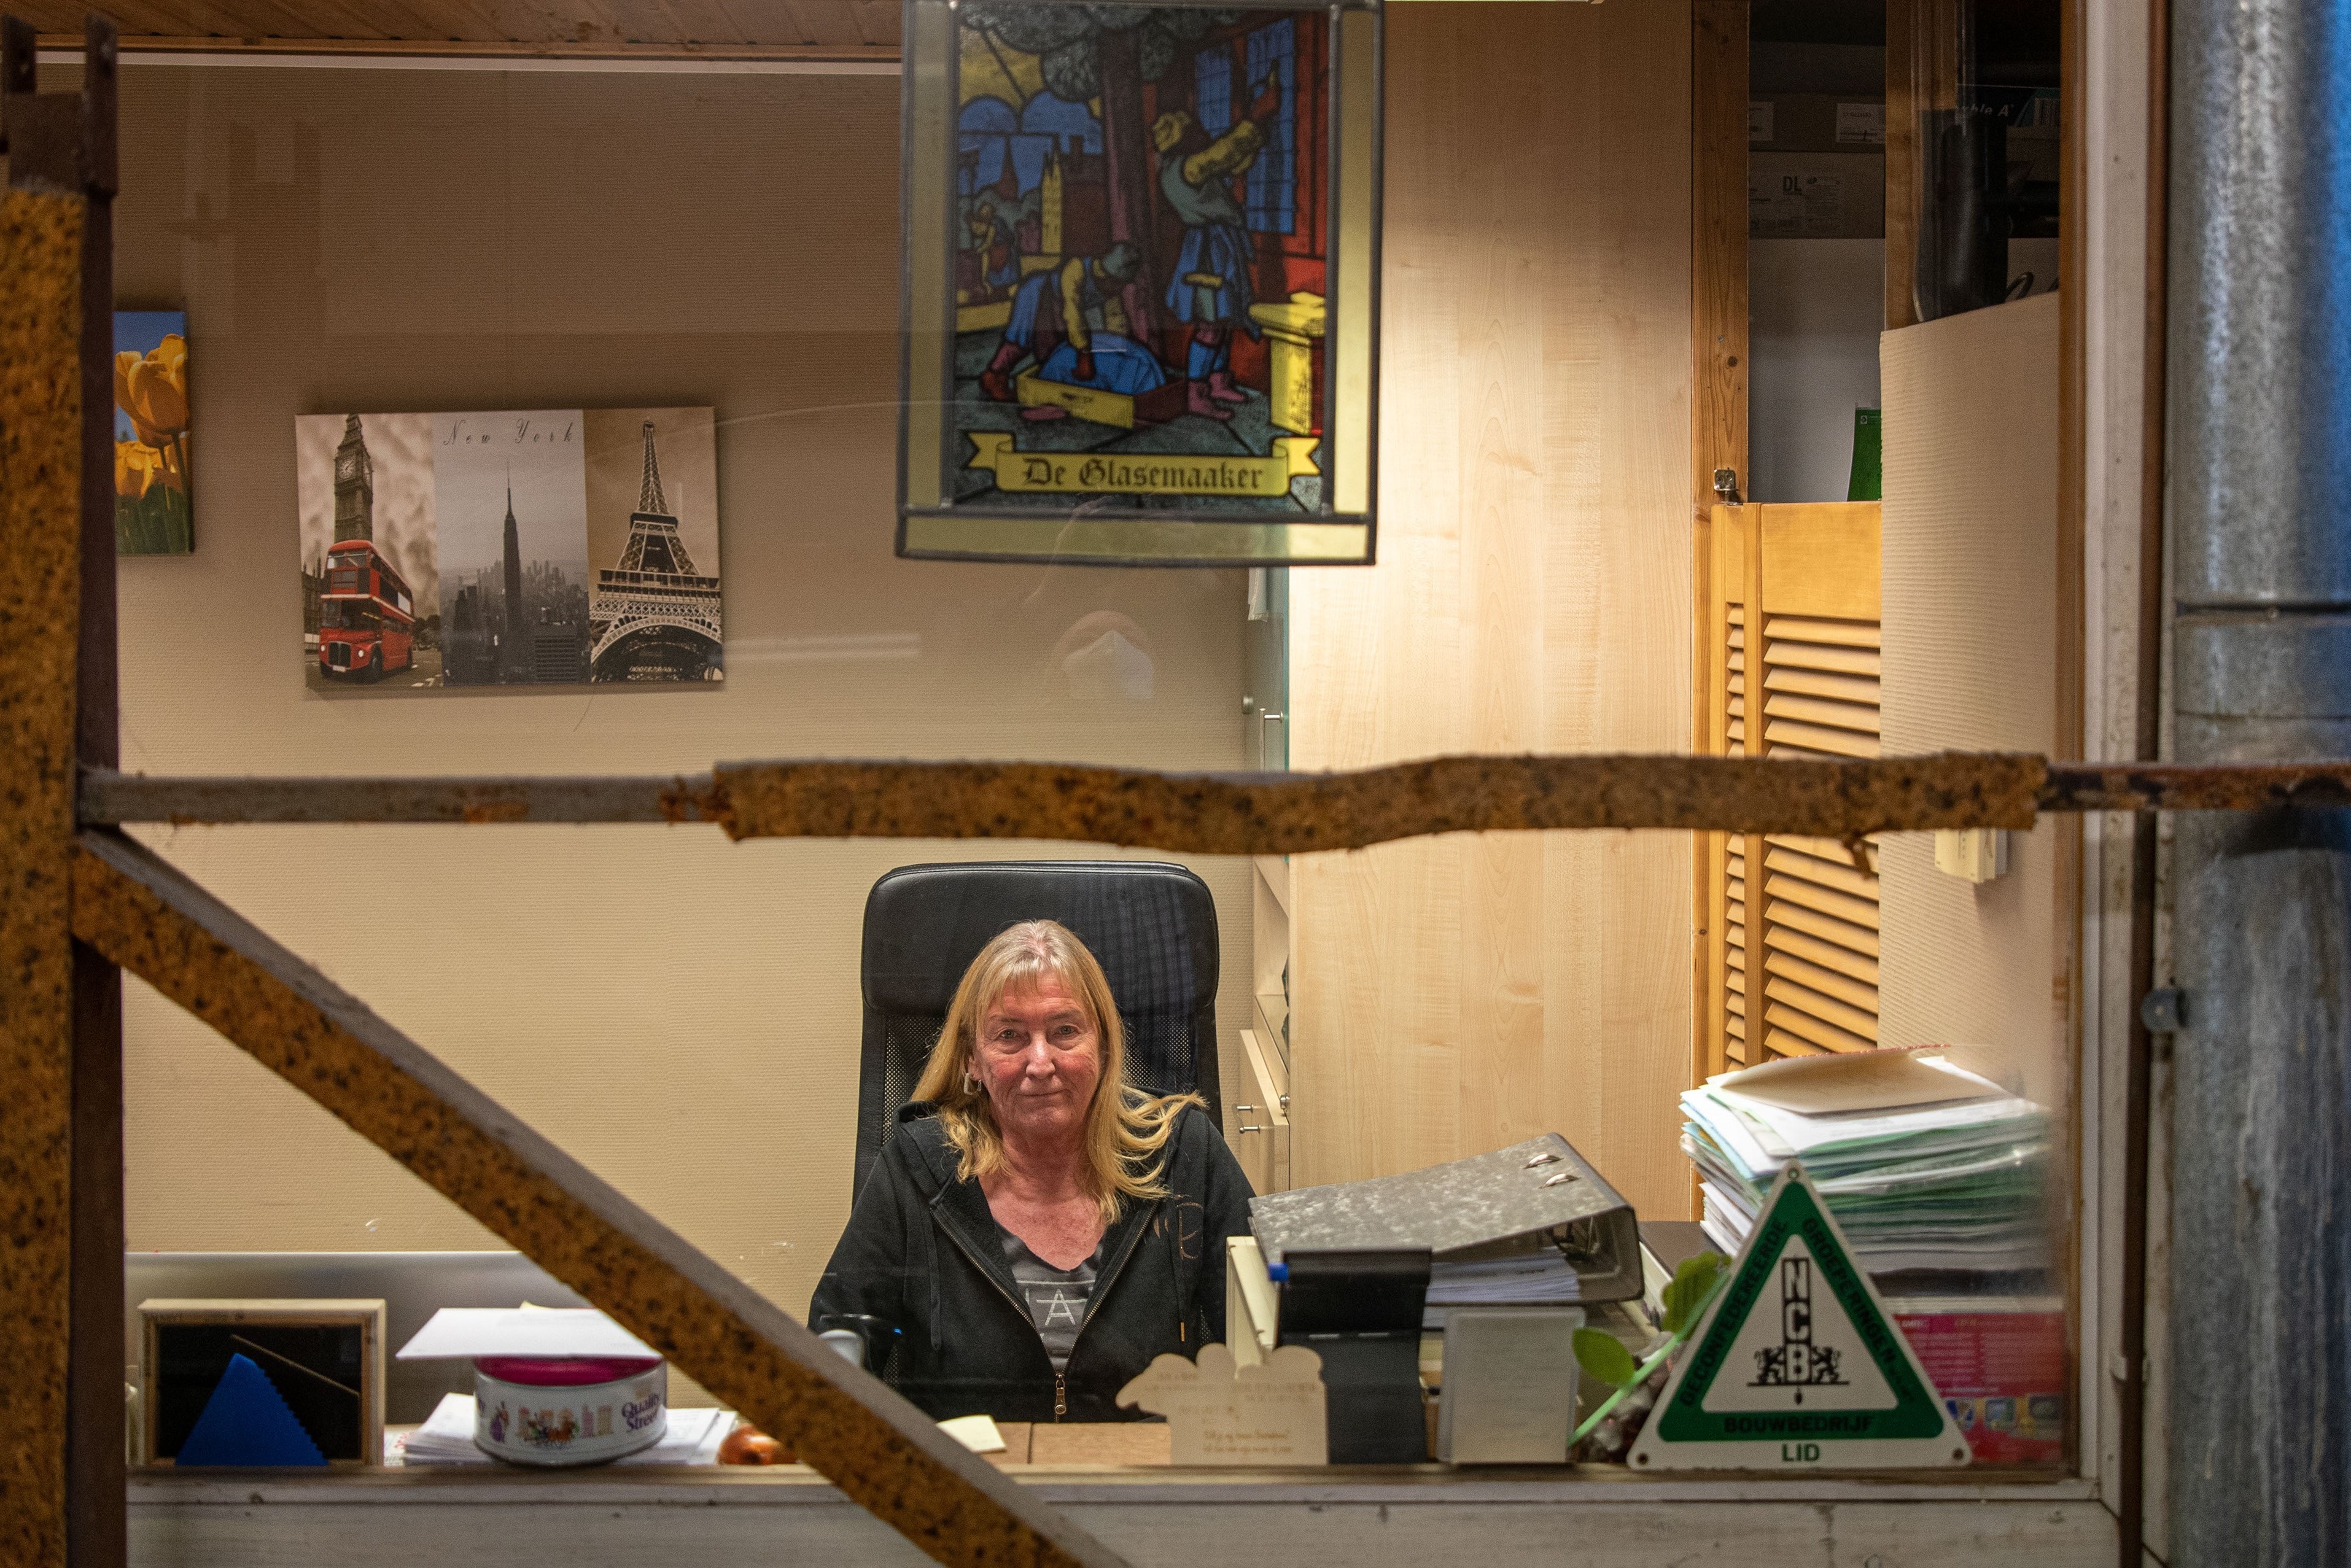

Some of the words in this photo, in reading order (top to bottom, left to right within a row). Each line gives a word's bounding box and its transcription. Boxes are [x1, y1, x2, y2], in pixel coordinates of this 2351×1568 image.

[1782, 176, 1803, 192] DL
[443, 419, 491, 446] New
[515, 418, 573, 444] York
[1021, 456, 1066, 487] De
[1078, 457, 1264, 491] Glasemaaker
[621, 1394, 659, 1418] Quality
[1723, 1415, 1875, 1435] BOUWBEDRIJF
[1781, 1443, 1821, 1462] LID
